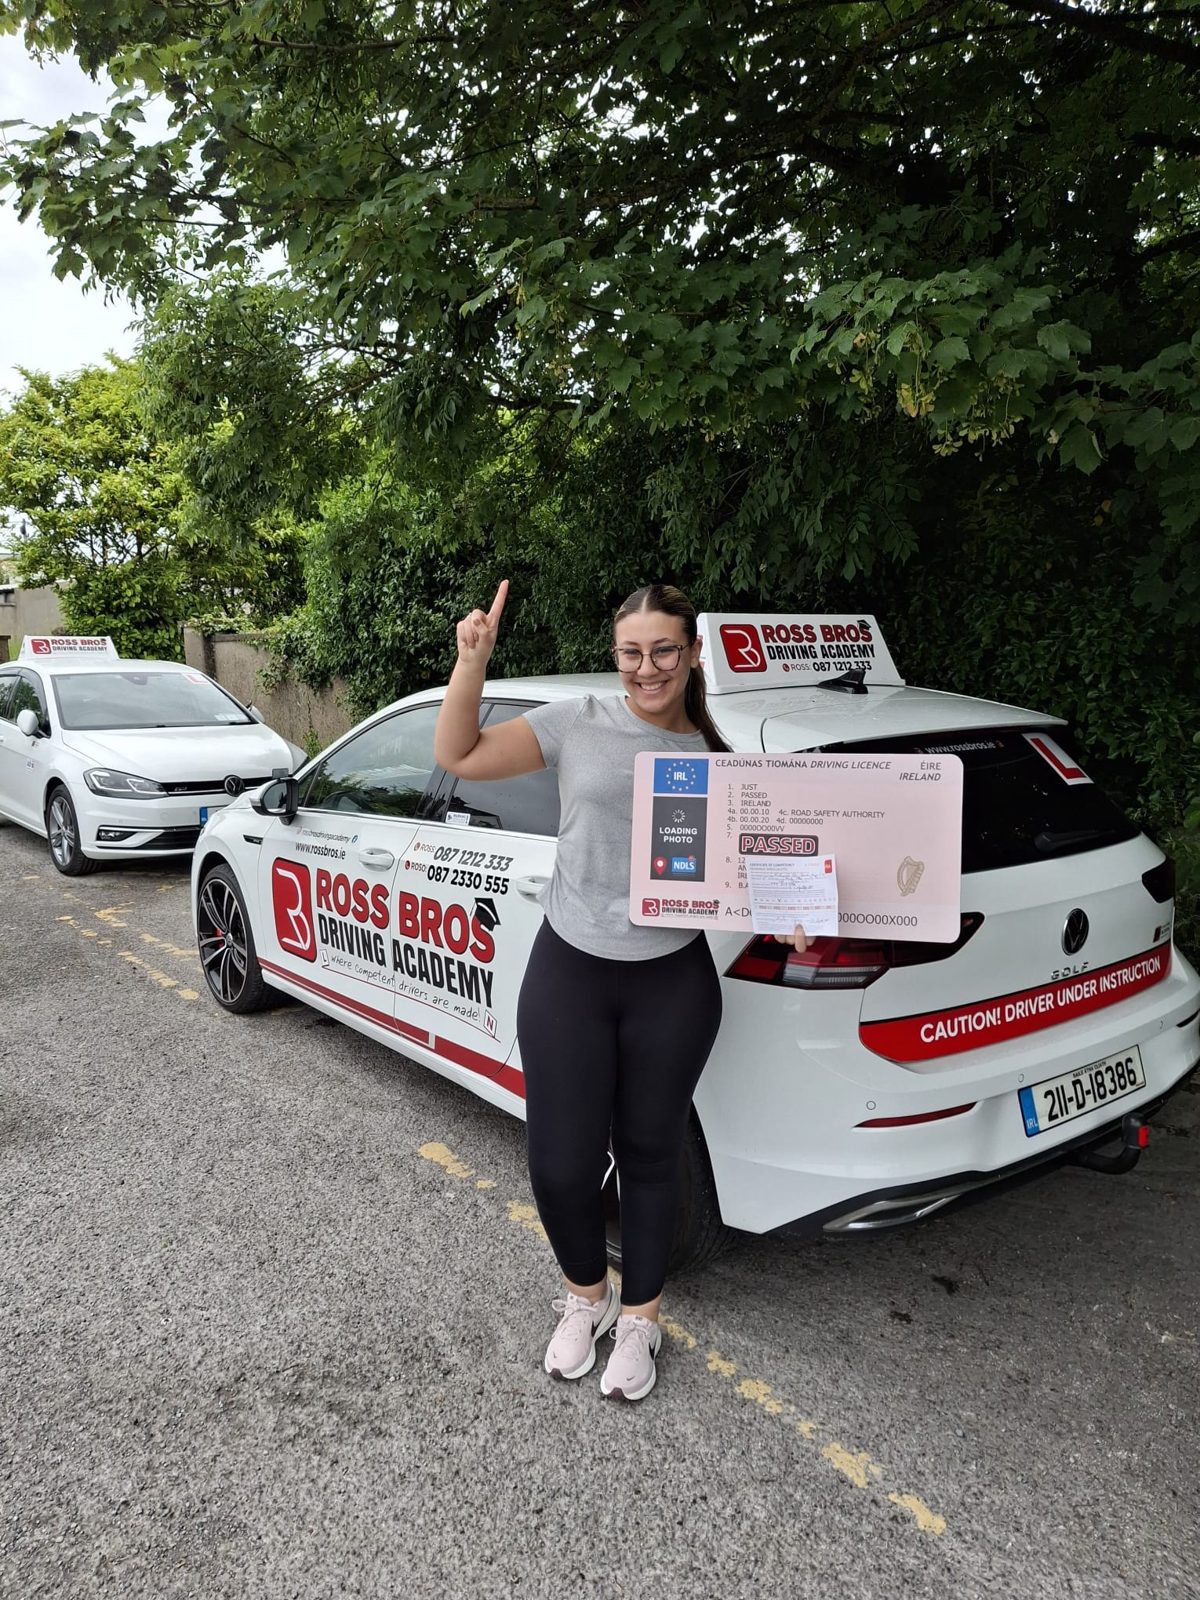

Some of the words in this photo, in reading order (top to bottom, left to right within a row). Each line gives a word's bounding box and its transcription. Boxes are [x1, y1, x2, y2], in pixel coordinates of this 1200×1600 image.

[760, 624, 817, 643] ROSS
[820, 624, 873, 643] BROS
[767, 644, 818, 660] DRIVING
[820, 644, 876, 659] ACADEMY
[790, 663, 811, 671] ROSS:
[812, 662, 831, 672] 087
[833, 661, 852, 672] 1212
[925, 741, 996, 754] www.rossbros.ie
[715, 758, 763, 768] CEADÚNAS
[766, 758, 808, 769] TIOMÁNA
[810, 760, 849, 769] DRIVING
[851, 761, 892, 770] LICENCE
[920, 760, 942, 770] ÉIRE
[1030, 738, 1088, 780] L
[673, 771, 688, 781] IRL
[899, 772, 941, 782] IRELAND
[659, 827, 698, 835] LOADING
[663, 836, 693, 844] PHOTO
[741, 835, 816, 854] PASSED
[295, 842, 346, 860] www.rossbros.ie
[433, 846, 459, 862] 087
[458, 849, 486, 868] 1212
[484, 854, 513, 871] 333
[673, 861, 695, 871] NDLS
[427, 865, 450, 883] 087
[450, 869, 482, 890] 2330
[484, 875, 510, 895] 555
[662, 899, 689, 908] ROSS
[692, 900, 720, 909] BROS
[688, 908, 718, 916] ACADEMY
[316, 867, 390, 930] ROSS
[399, 890, 496, 964] BROS
[318, 913, 387, 968] DRIVING
[392, 938, 494, 1009] ACADEMY
[1050, 961, 1089, 981] GOLF
[330, 954, 352, 970] where
[354, 964, 396, 986] competent
[399, 980, 428, 1000] drivers
[432, 996, 449, 1009] are
[453, 1005, 481, 1023] made!
[920, 1007, 1001, 1043] CAUTION!
[1005, 993, 1054, 1023] DRIVER
[1057, 979, 1097, 1007] UNDER
[1099, 955, 1161, 993] INSTRUCTION
[1044, 1057, 1137, 1122] 211-D-18386
[1027, 1118, 1038, 1129] IRL
